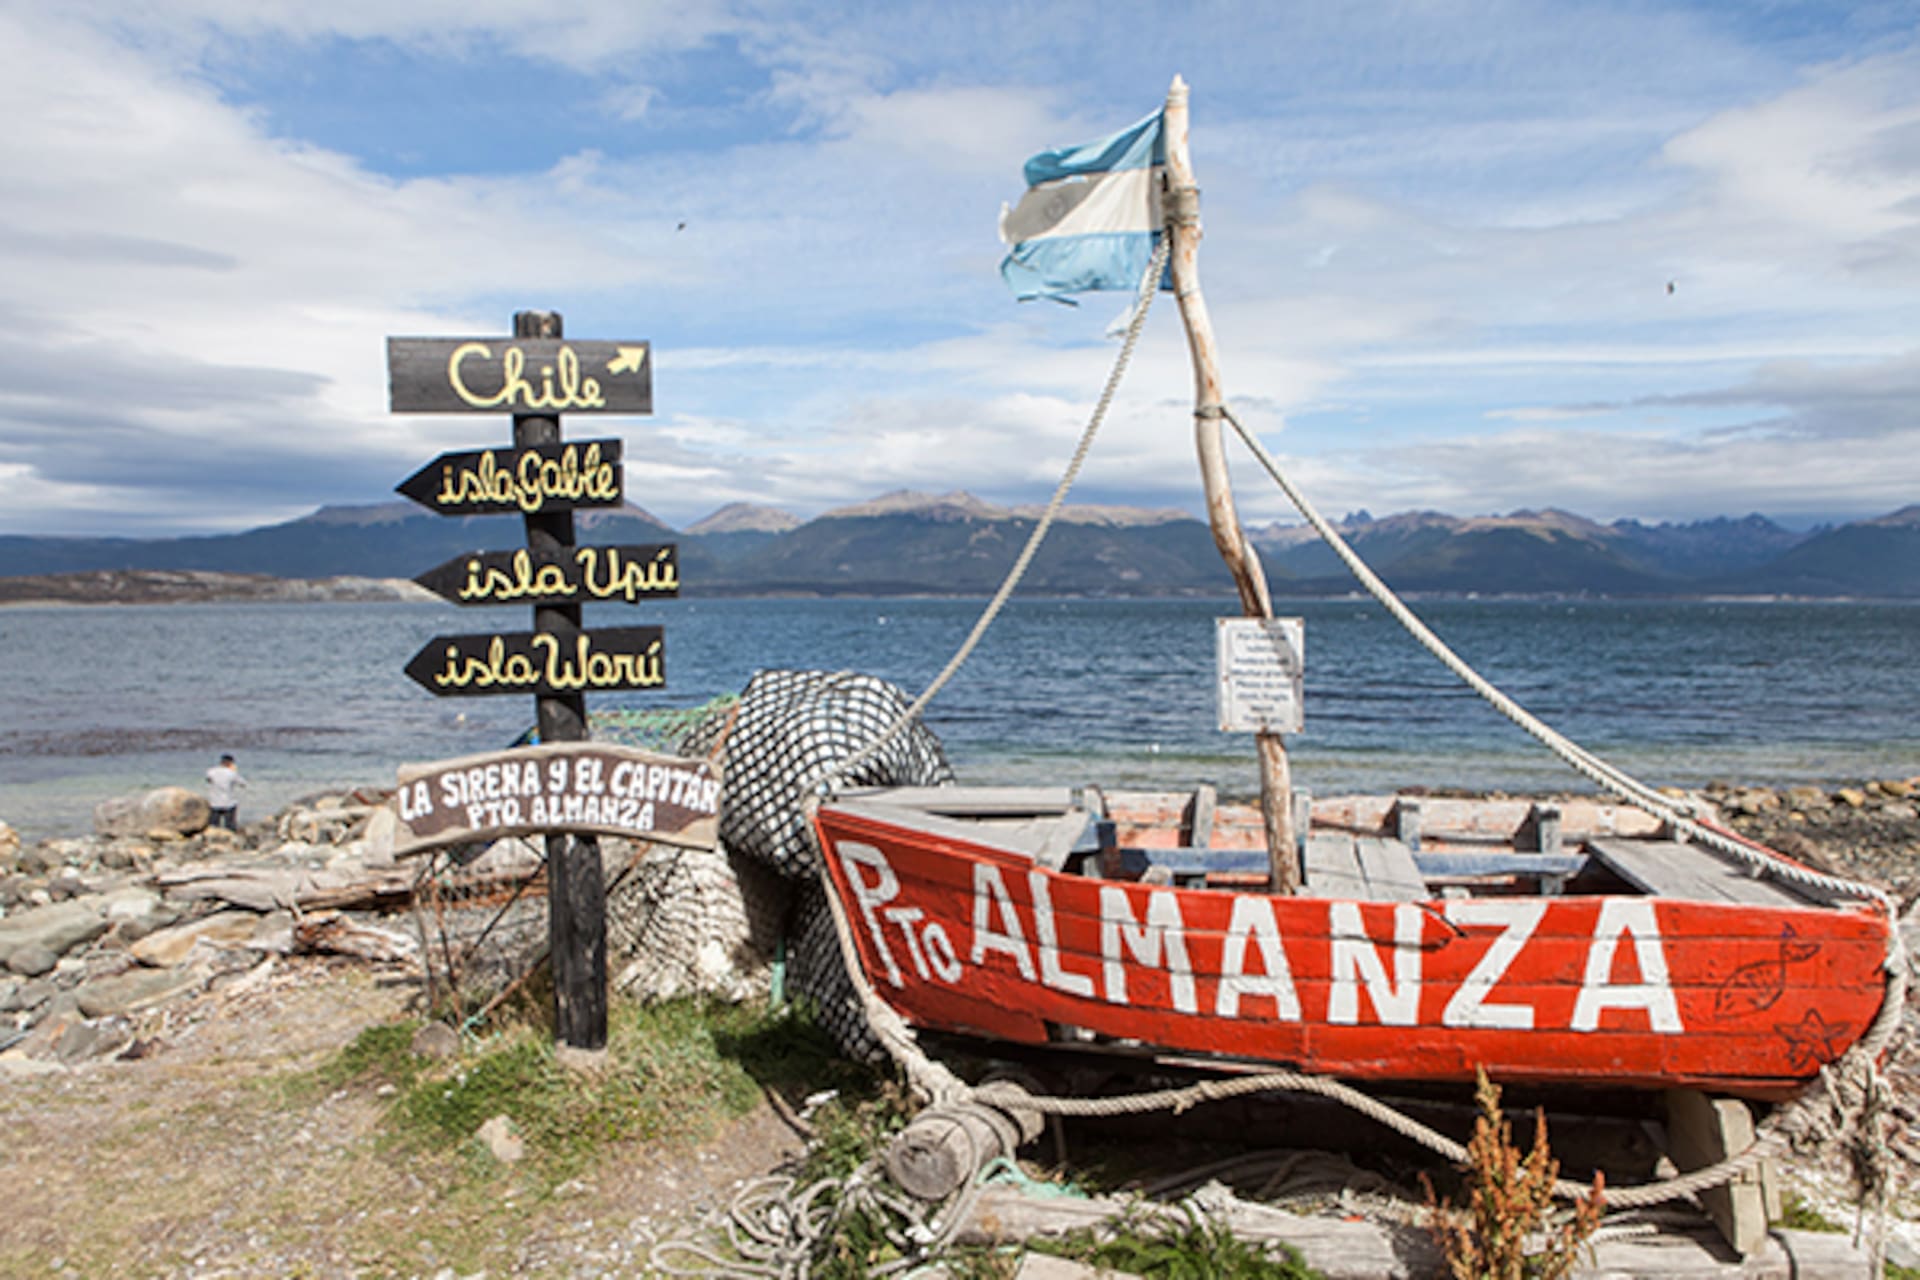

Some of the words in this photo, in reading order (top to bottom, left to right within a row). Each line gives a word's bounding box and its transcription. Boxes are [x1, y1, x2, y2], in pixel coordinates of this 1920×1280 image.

[449, 342, 606, 408] Chile
[437, 450, 517, 503] isla
[459, 548, 577, 599] isla
[575, 547, 680, 601] Upú
[434, 636, 540, 686] isla
[531, 633, 665, 690] Warú
[398, 780, 433, 821] LA
[440, 760, 542, 808] SIRENA
[575, 757, 605, 794] EL
[610, 761, 720, 815] CAPITÁN
[531, 794, 655, 831] ALMANZA
[971, 862, 1685, 1034] ALMANZA
